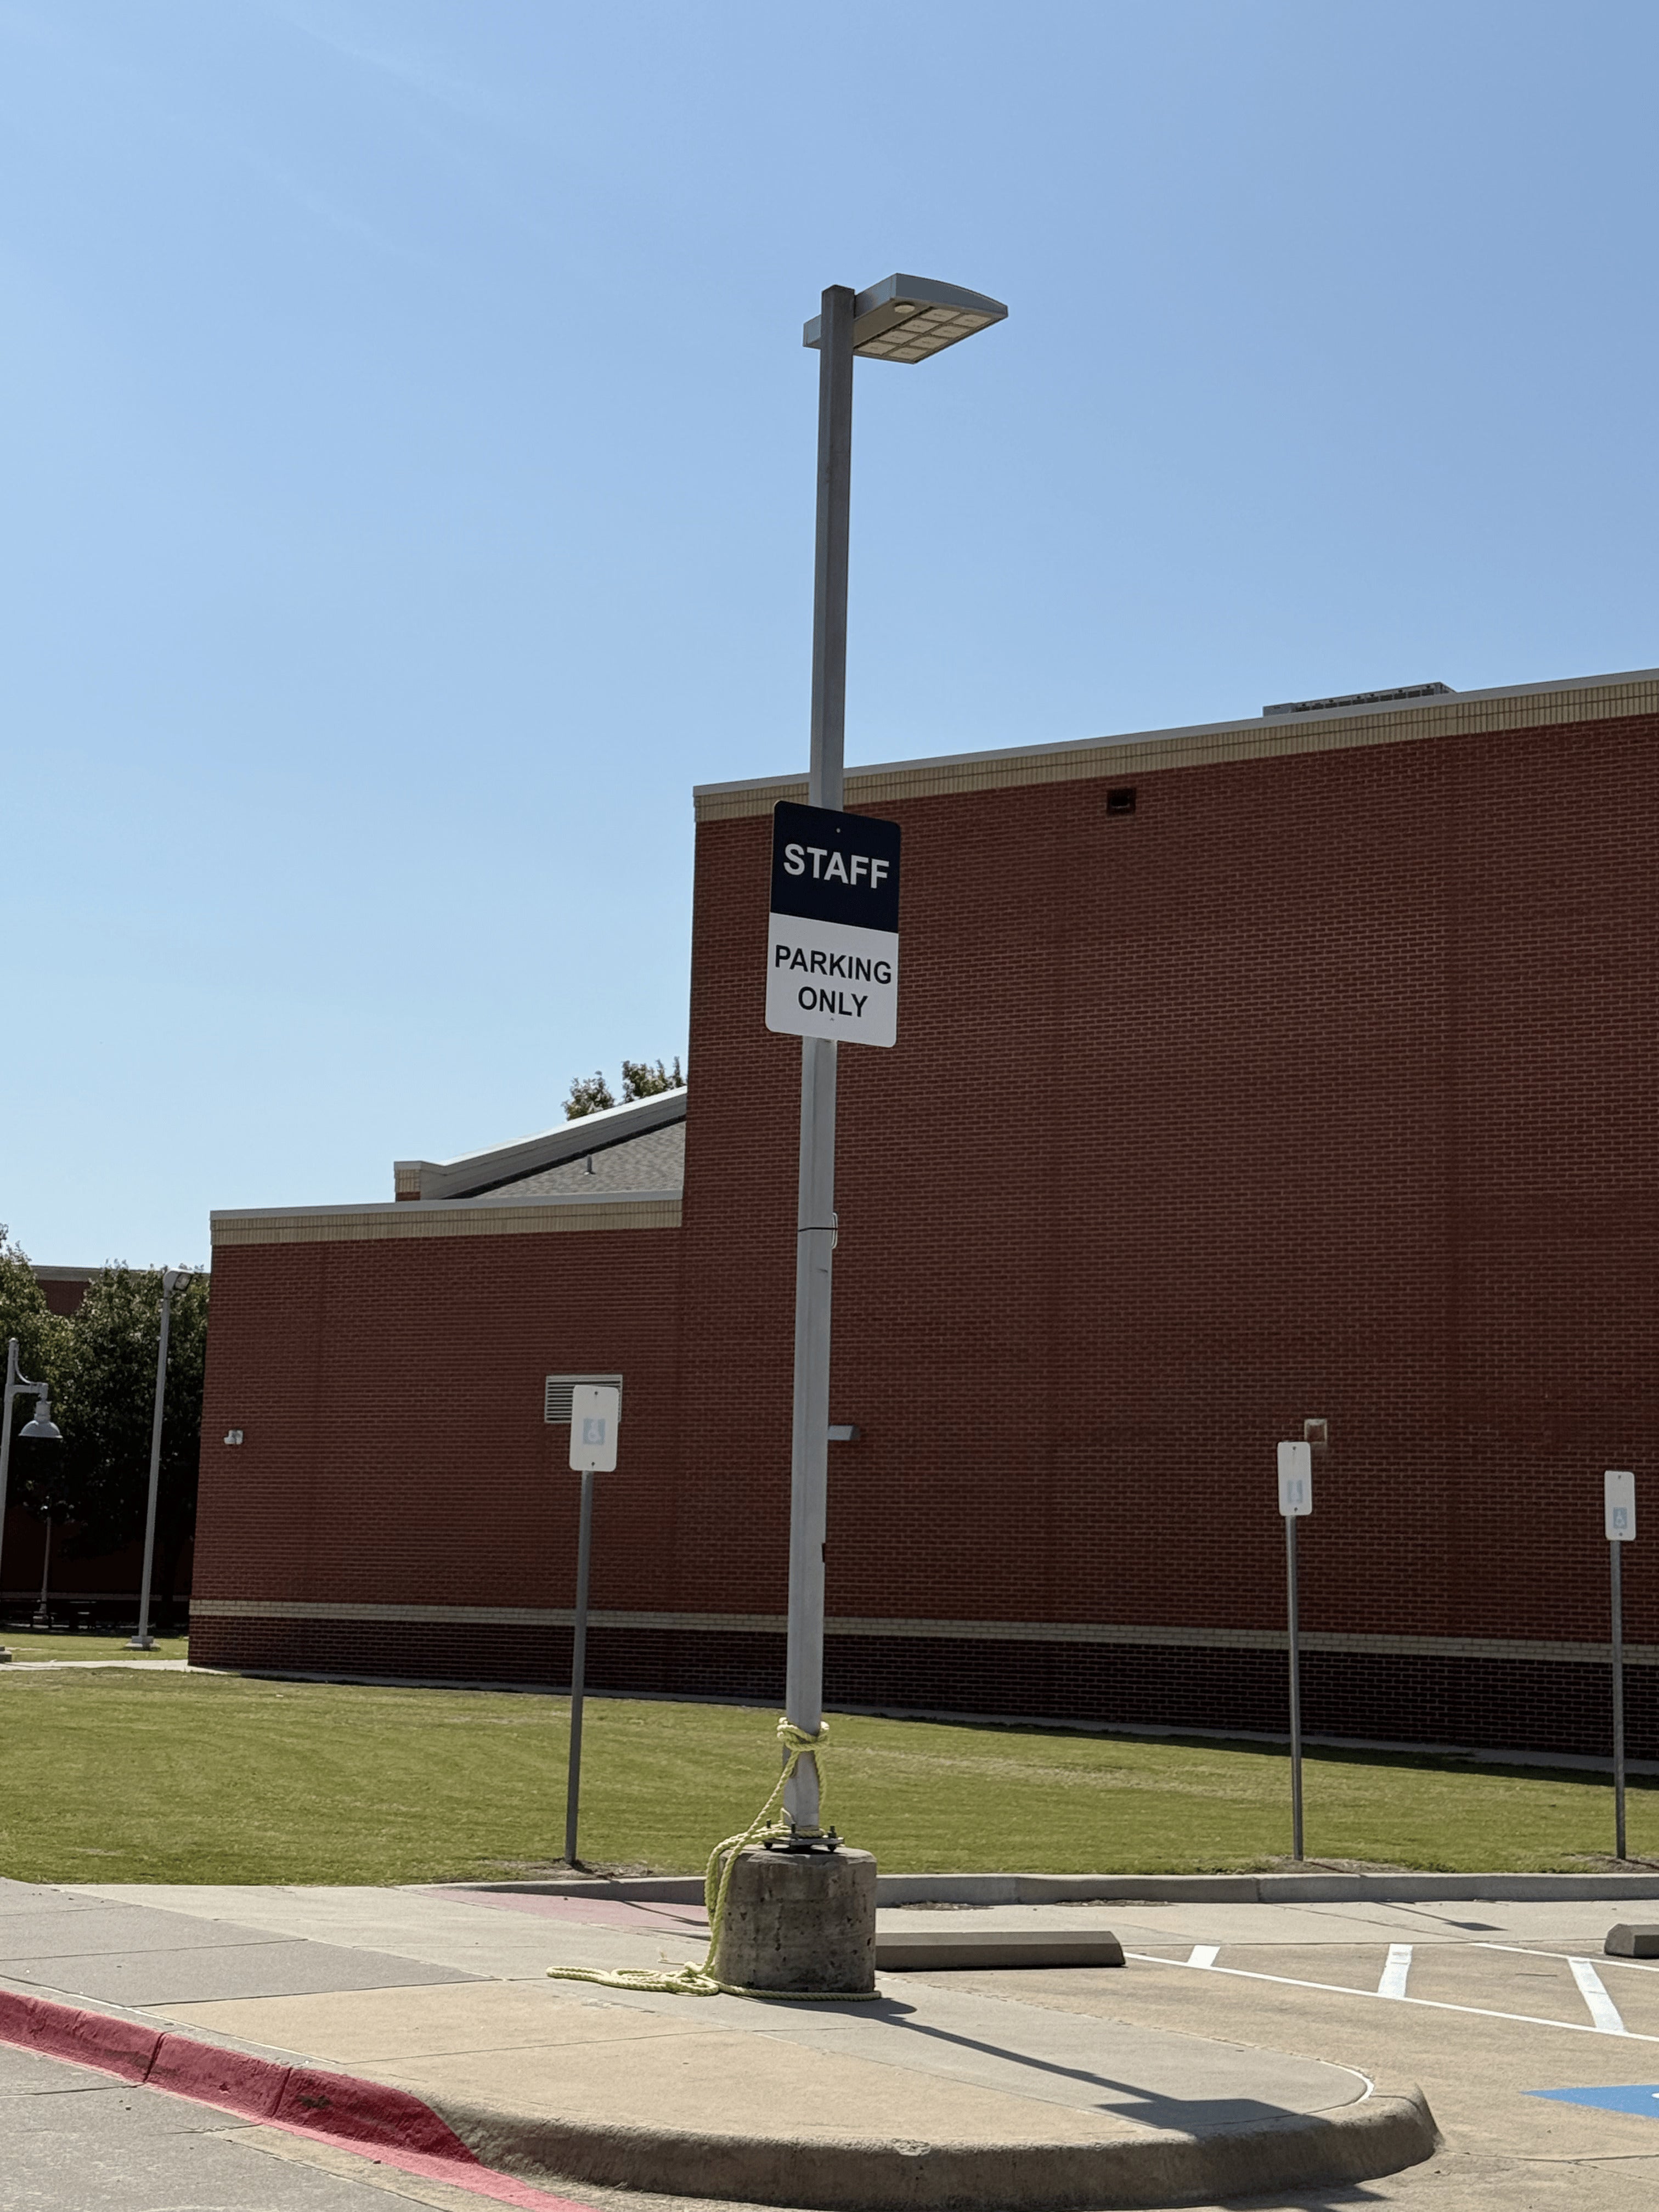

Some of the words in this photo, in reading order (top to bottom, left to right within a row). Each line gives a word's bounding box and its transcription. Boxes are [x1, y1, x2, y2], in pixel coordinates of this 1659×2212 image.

[783, 843, 889, 889] STAFF
[775, 945, 891, 984] PARKING
[798, 986, 868, 1018] ONLY
